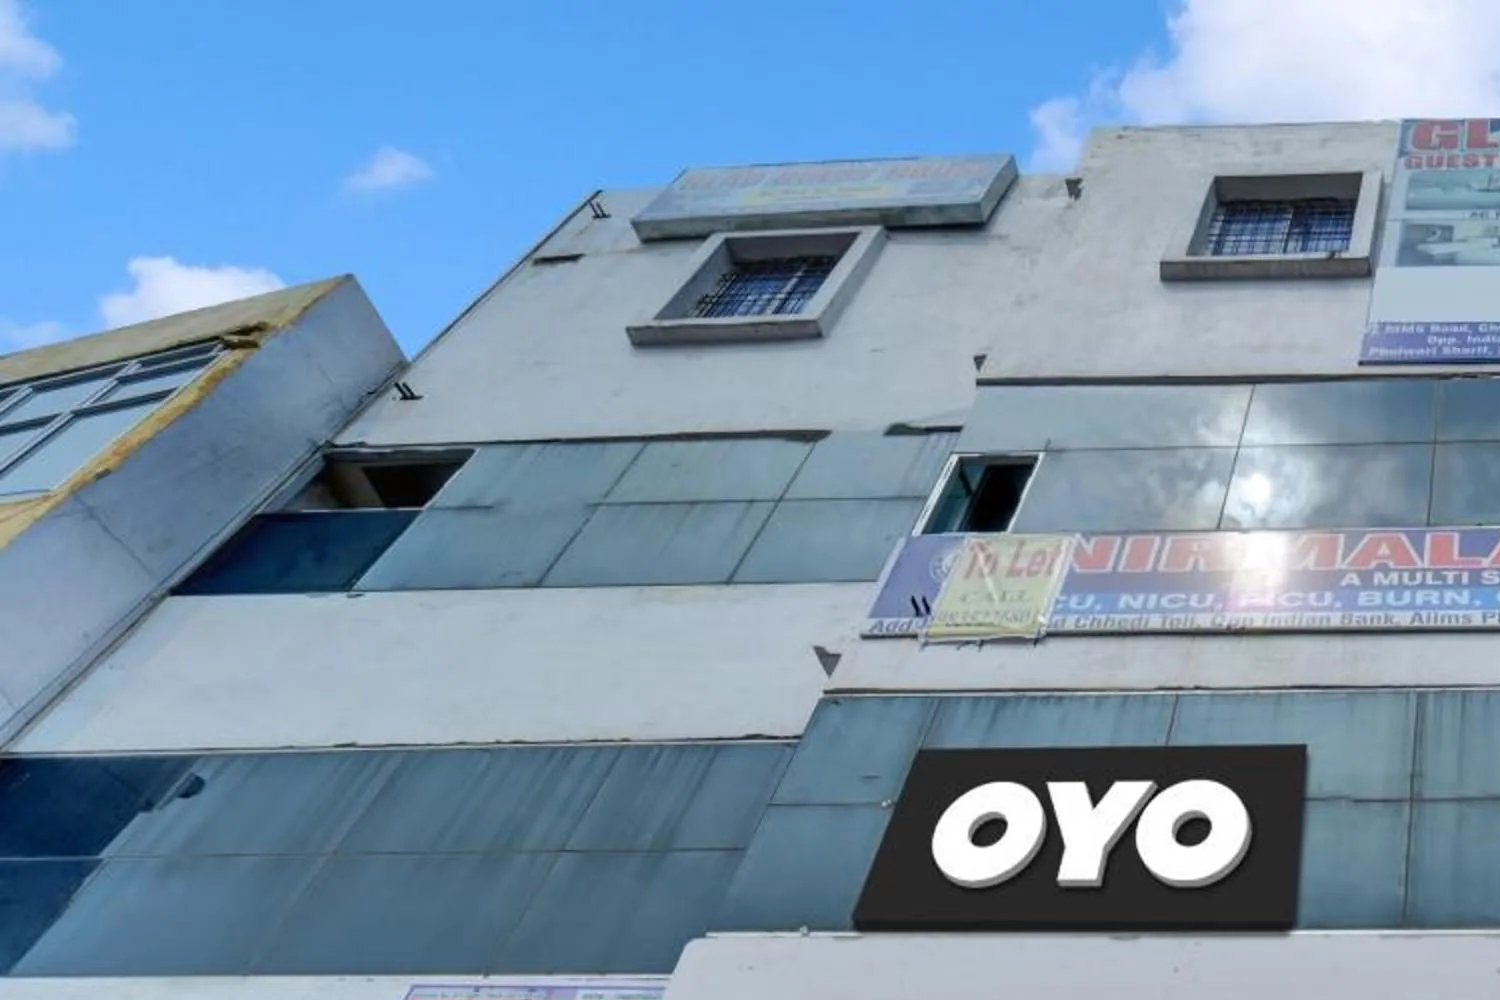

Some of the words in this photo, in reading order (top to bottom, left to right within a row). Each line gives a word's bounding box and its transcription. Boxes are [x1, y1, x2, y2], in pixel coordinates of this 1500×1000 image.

[1404, 153, 1499, 170] GUEST
[1339, 572, 1361, 587] A
[1373, 570, 1469, 586] MULTI
[1117, 592, 1223, 610] NICU,
[1356, 589, 1482, 607] BURN,
[931, 778, 1253, 889] OYO
